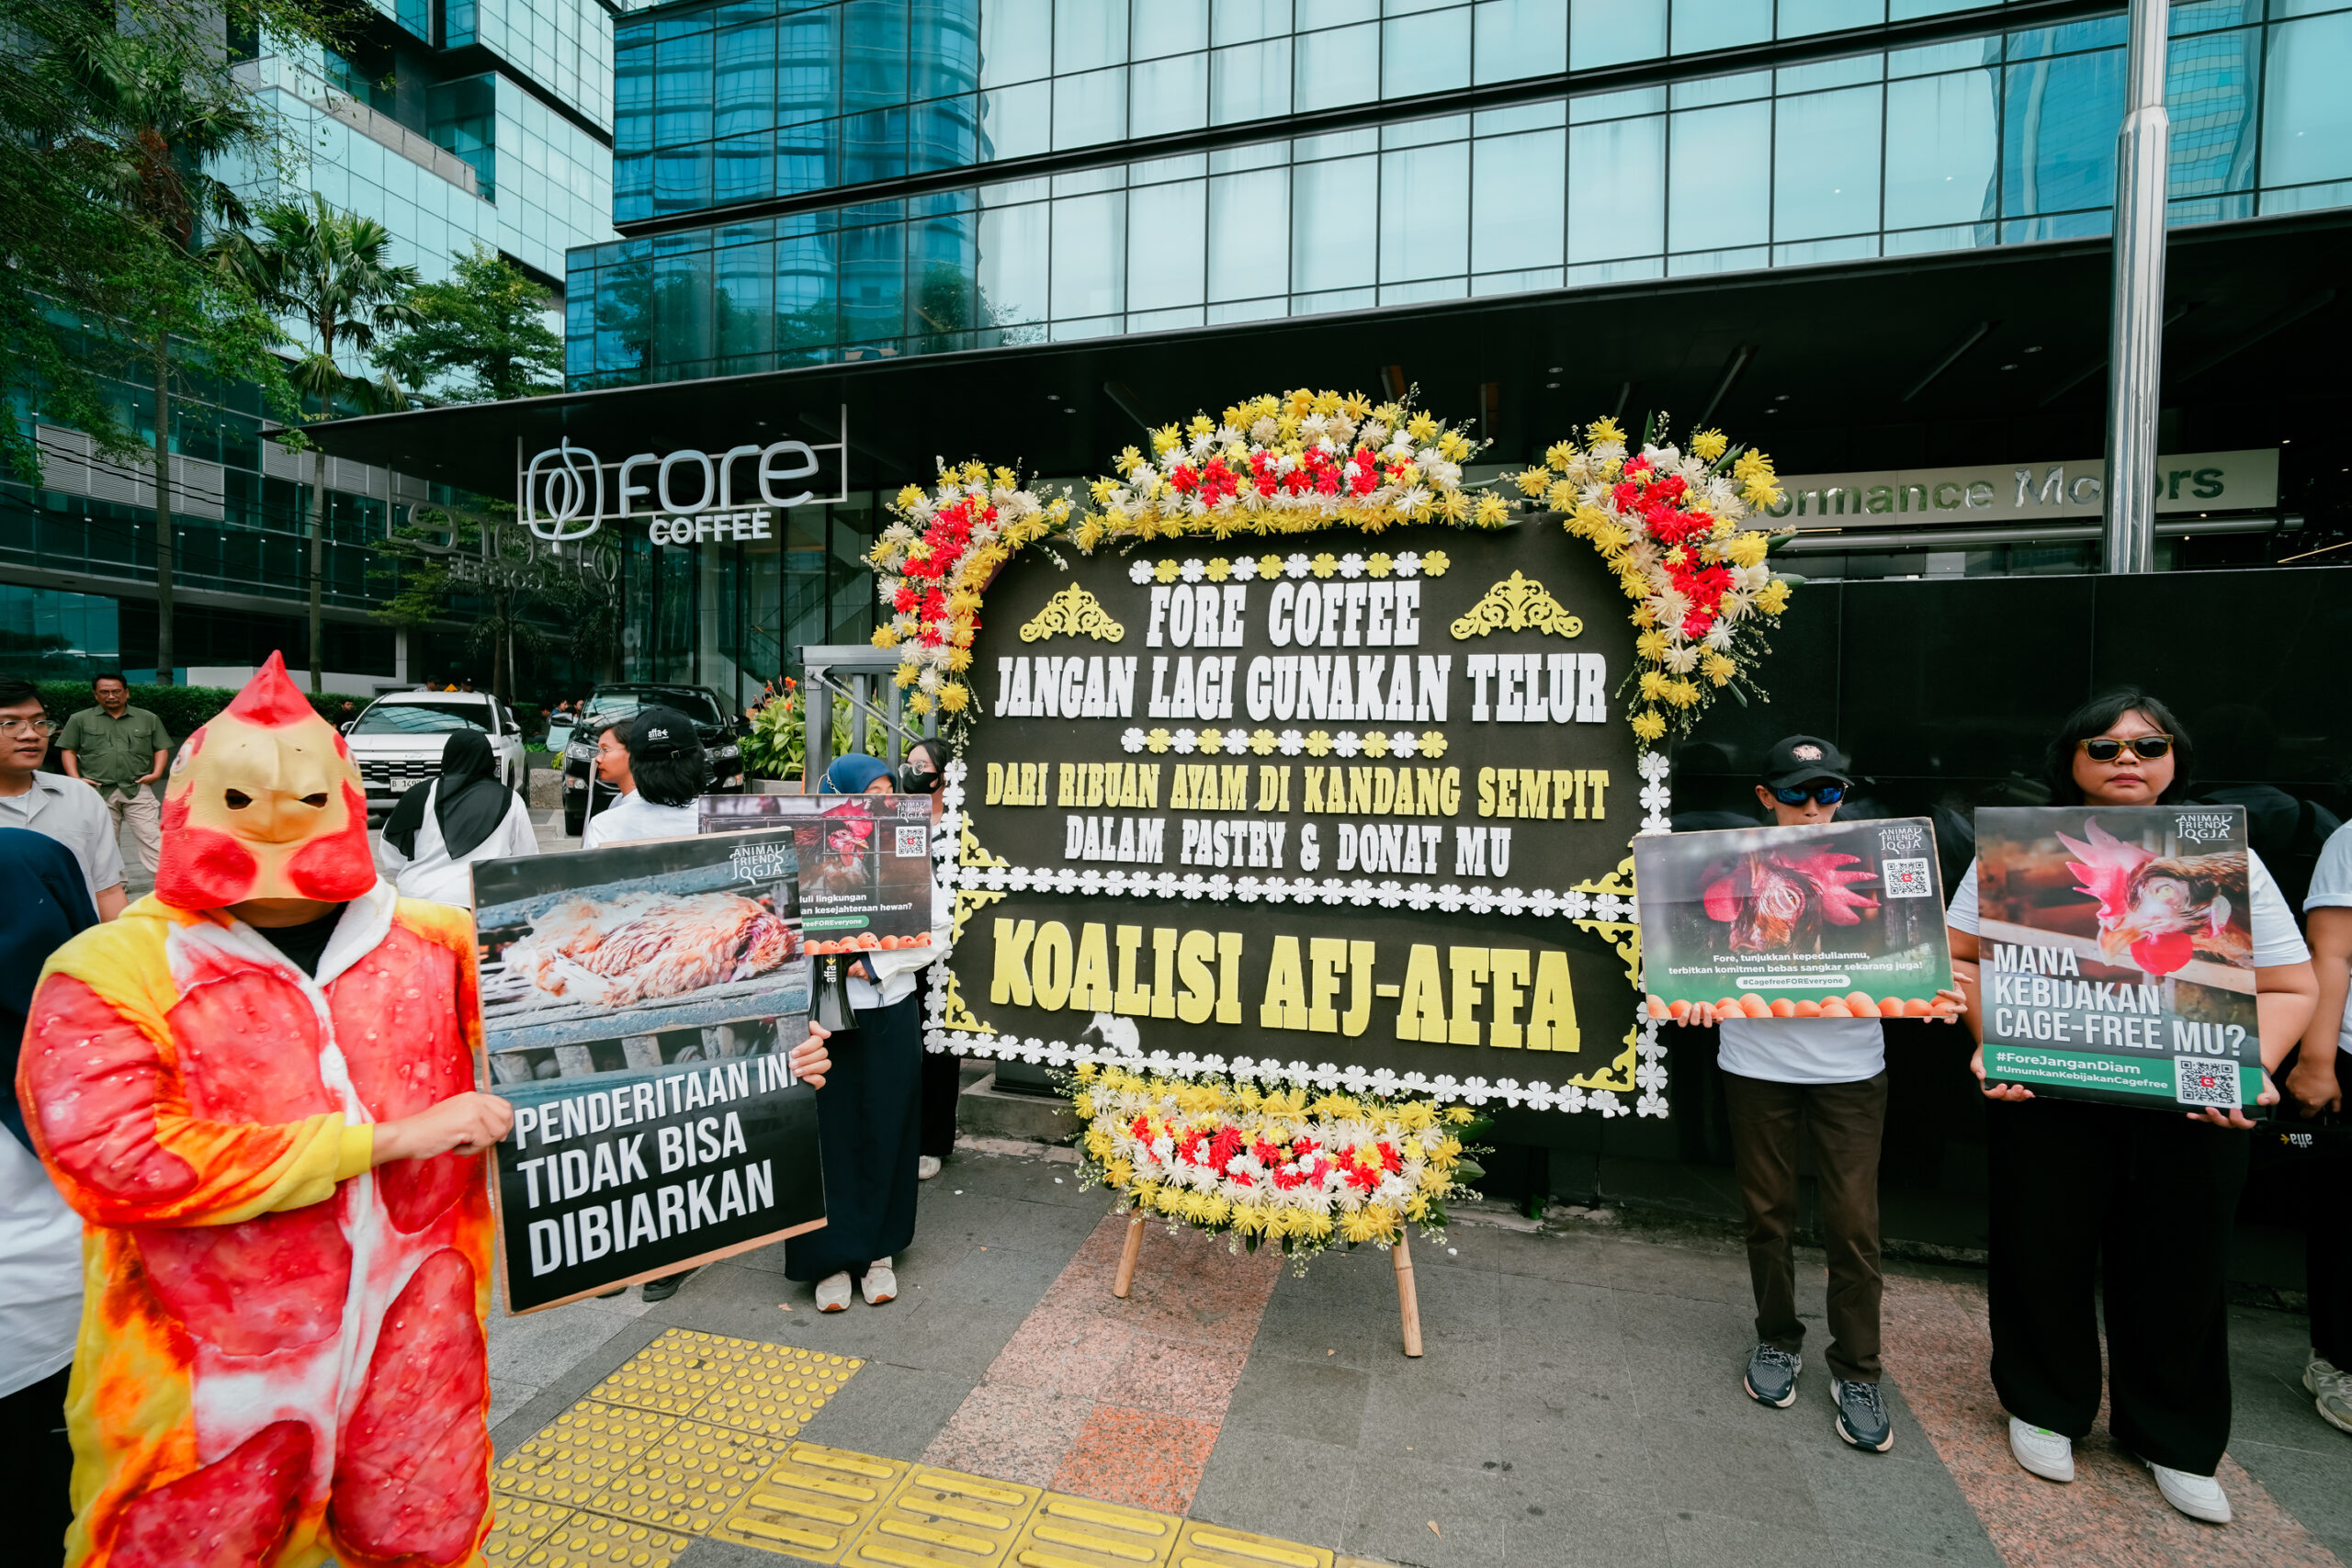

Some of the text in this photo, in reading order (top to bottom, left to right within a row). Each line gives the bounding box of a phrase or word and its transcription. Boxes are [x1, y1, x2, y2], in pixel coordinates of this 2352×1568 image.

[1750, 466, 2224, 518] ormance Mors
[649, 512, 772, 546] COFFEE
[1146, 580, 1420, 648] FORE COFFEE
[994, 652, 1607, 724] JANGAN LAGI GUNAKAN TELUR
[986, 762, 1610, 819] DARI RIBUAN AYAM DI KANDANG SEMPIT
[897, 812, 924, 823] JOGJA
[2178, 821, 2231, 830] FRIENDS
[1881, 833, 1922, 841] FRIENDS
[1882, 827, 1918, 835] ANIMAL
[2177, 829, 2230, 844] JOGJA
[734, 844, 779, 857] ANIMAL
[1065, 815, 1511, 877] DALAM PASTRY & DONAT MU
[1882, 840, 1921, 854] JOGJA
[732, 853, 784, 865] FRIENDS
[731, 863, 783, 886] JOGJA
[815, 904, 878, 915] kesejahteraan
[880, 902, 912, 912] hewan?
[816, 894, 866, 904] lingkungan
[801, 919, 863, 928] reeFOREveryone
[1668, 961, 1923, 975] terbitkan komitmen bebas sangkar sekarang juga!
[1713, 952, 1870, 963] Fore, tunjukkan kepedulianmu,
[1993, 943, 2079, 977] MANA
[824, 965, 837, 983] affa
[989, 917, 1580, 1053] KOALISI AFJ-AFFA
[1743, 977, 1844, 987] #CagefreeFOREveryone
[1994, 976, 2160, 1015] KEBIJAKAN
[1995, 1009, 2246, 1056] CAGE-FREE MU?
[1996, 1052, 2141, 1075] #ForeJanganDiam
[1996, 1065, 2168, 1089] #UmumkanKebijakanCagefree
[514, 1051, 798, 1151] PENDERITAAN INI
[516, 1111, 748, 1209] TIDAK BISA
[527, 1159, 775, 1278] DIBIARKAN
